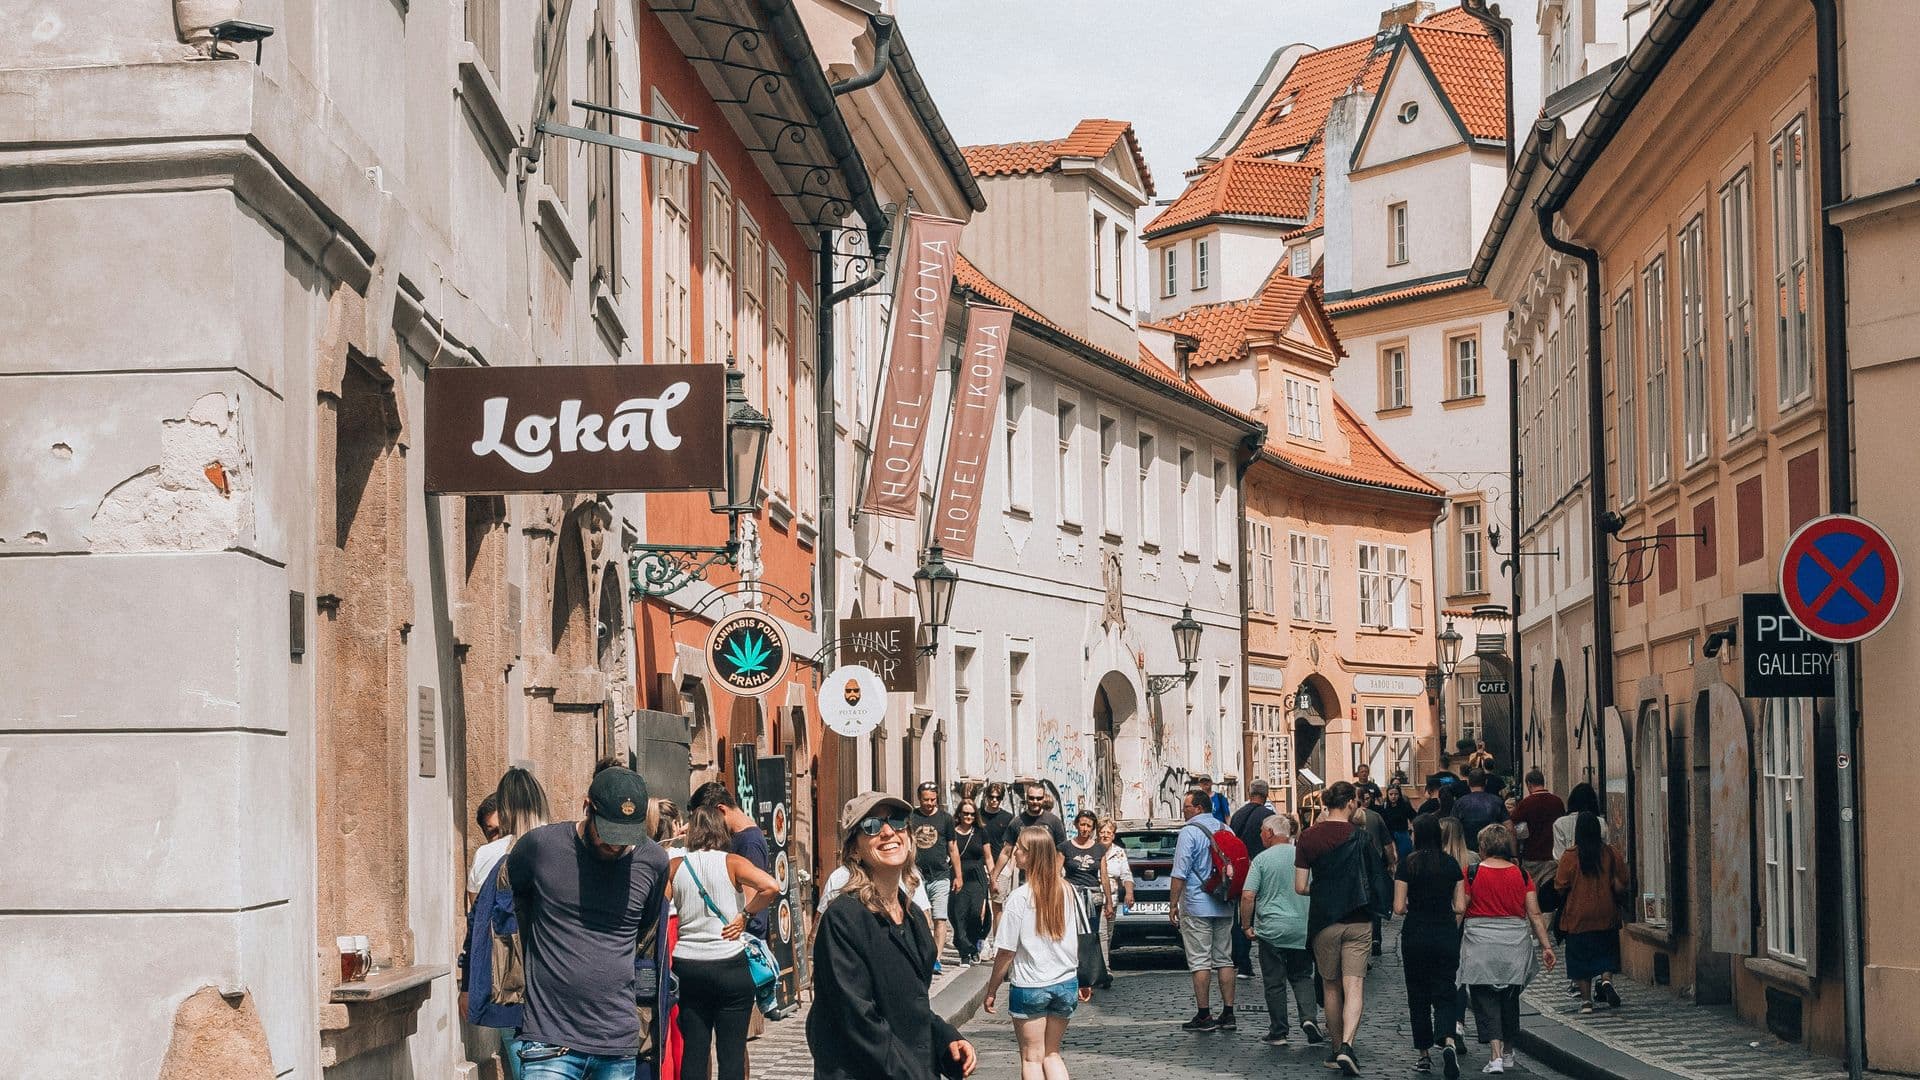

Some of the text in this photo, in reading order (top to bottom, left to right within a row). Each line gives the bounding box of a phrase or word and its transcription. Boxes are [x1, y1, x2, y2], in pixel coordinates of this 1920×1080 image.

[880, 239, 948, 498] HOTEL IKONA
[944, 324, 1001, 543] HOTEL IKONA
[714, 619, 782, 651] CANNABIS POINT
[851, 630, 902, 653] WINE
[1758, 652, 1834, 676] GALLERY
[728, 671, 771, 687] PRAHA
